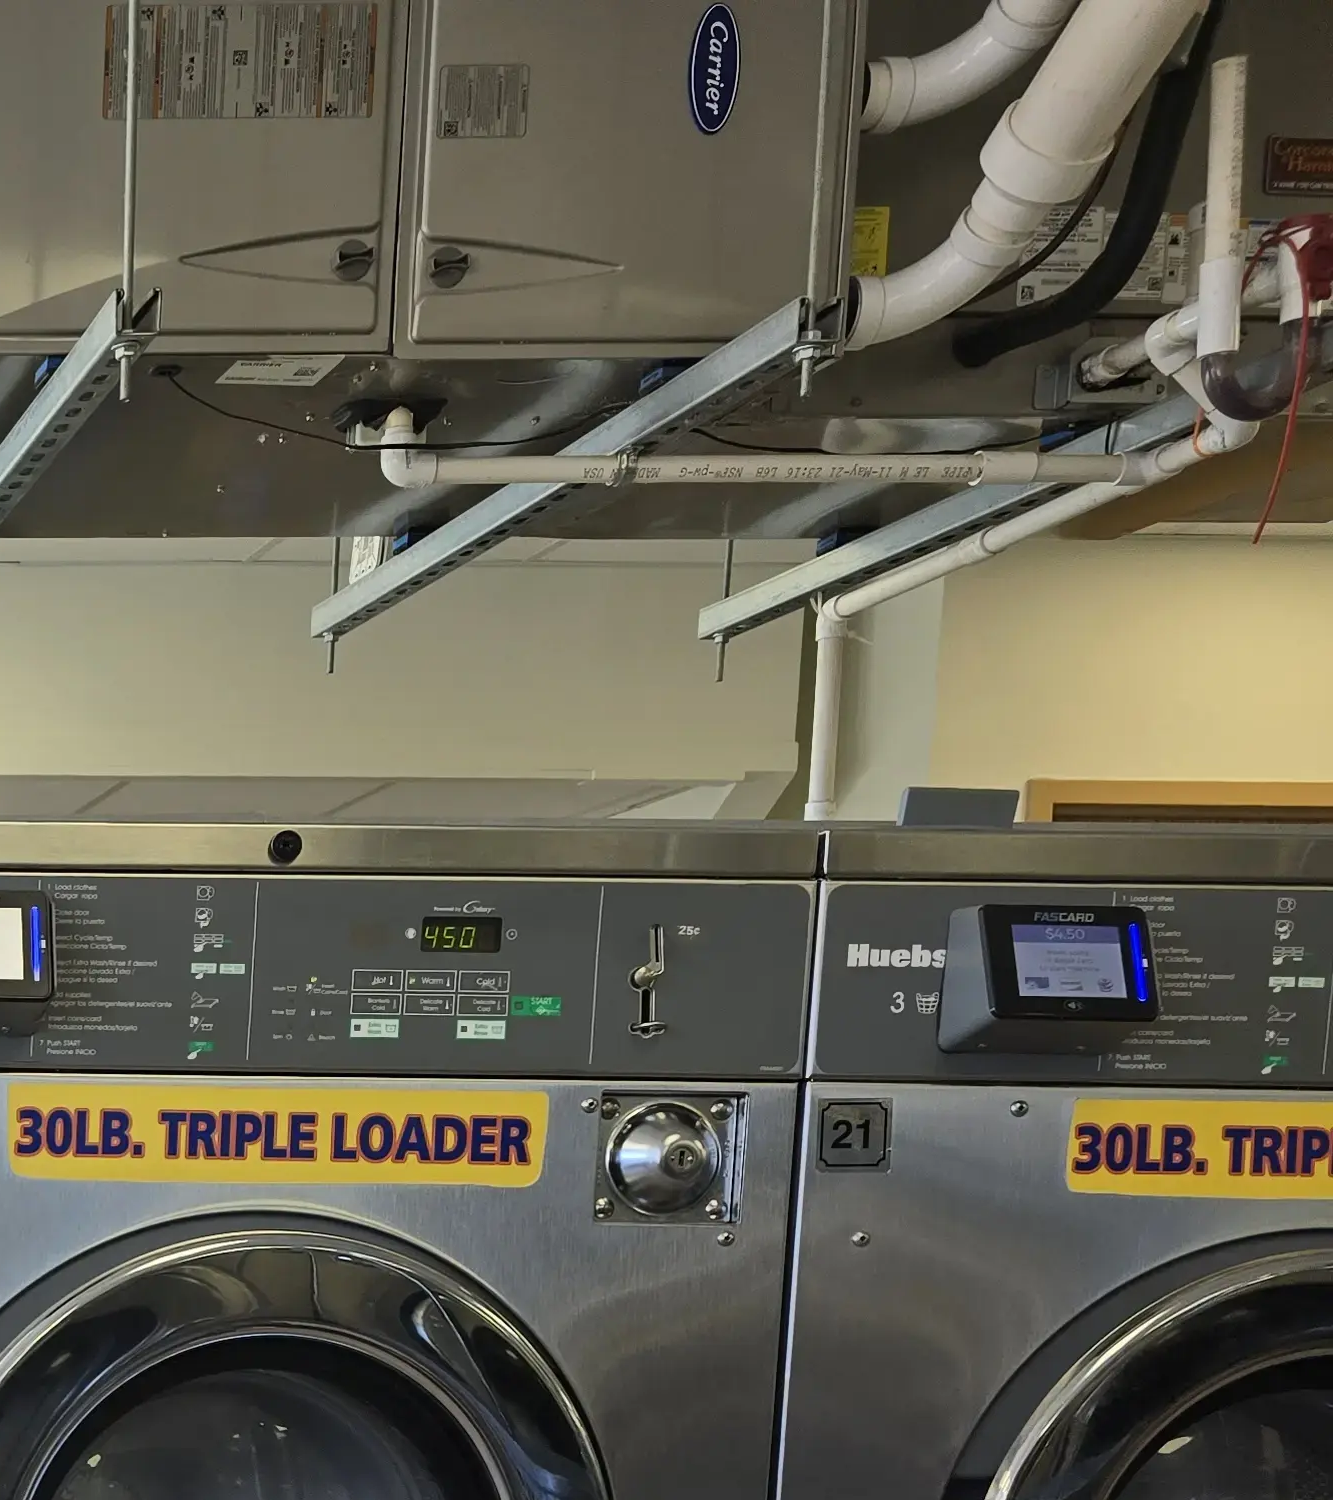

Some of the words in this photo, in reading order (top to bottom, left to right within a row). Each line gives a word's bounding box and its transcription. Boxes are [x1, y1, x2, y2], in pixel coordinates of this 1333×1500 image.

[706, 21, 728, 115] Carrier
[583, 467, 605, 478] USA
[1034, 911, 1095, 922] FASCARD
[424, 926, 476, 948] 450
[678, 926, 701, 936] 25¢
[1044, 928, 1085, 940] $4.50
[891, 993, 904, 1013] 3
[14, 1107, 145, 1159] 30LB.
[158, 1109, 318, 1163] TRIPLE
[329, 1112, 532, 1165] LOADER
[831, 1119, 871, 1149] 21
[1072, 1122, 1208, 1176] 30LB.
